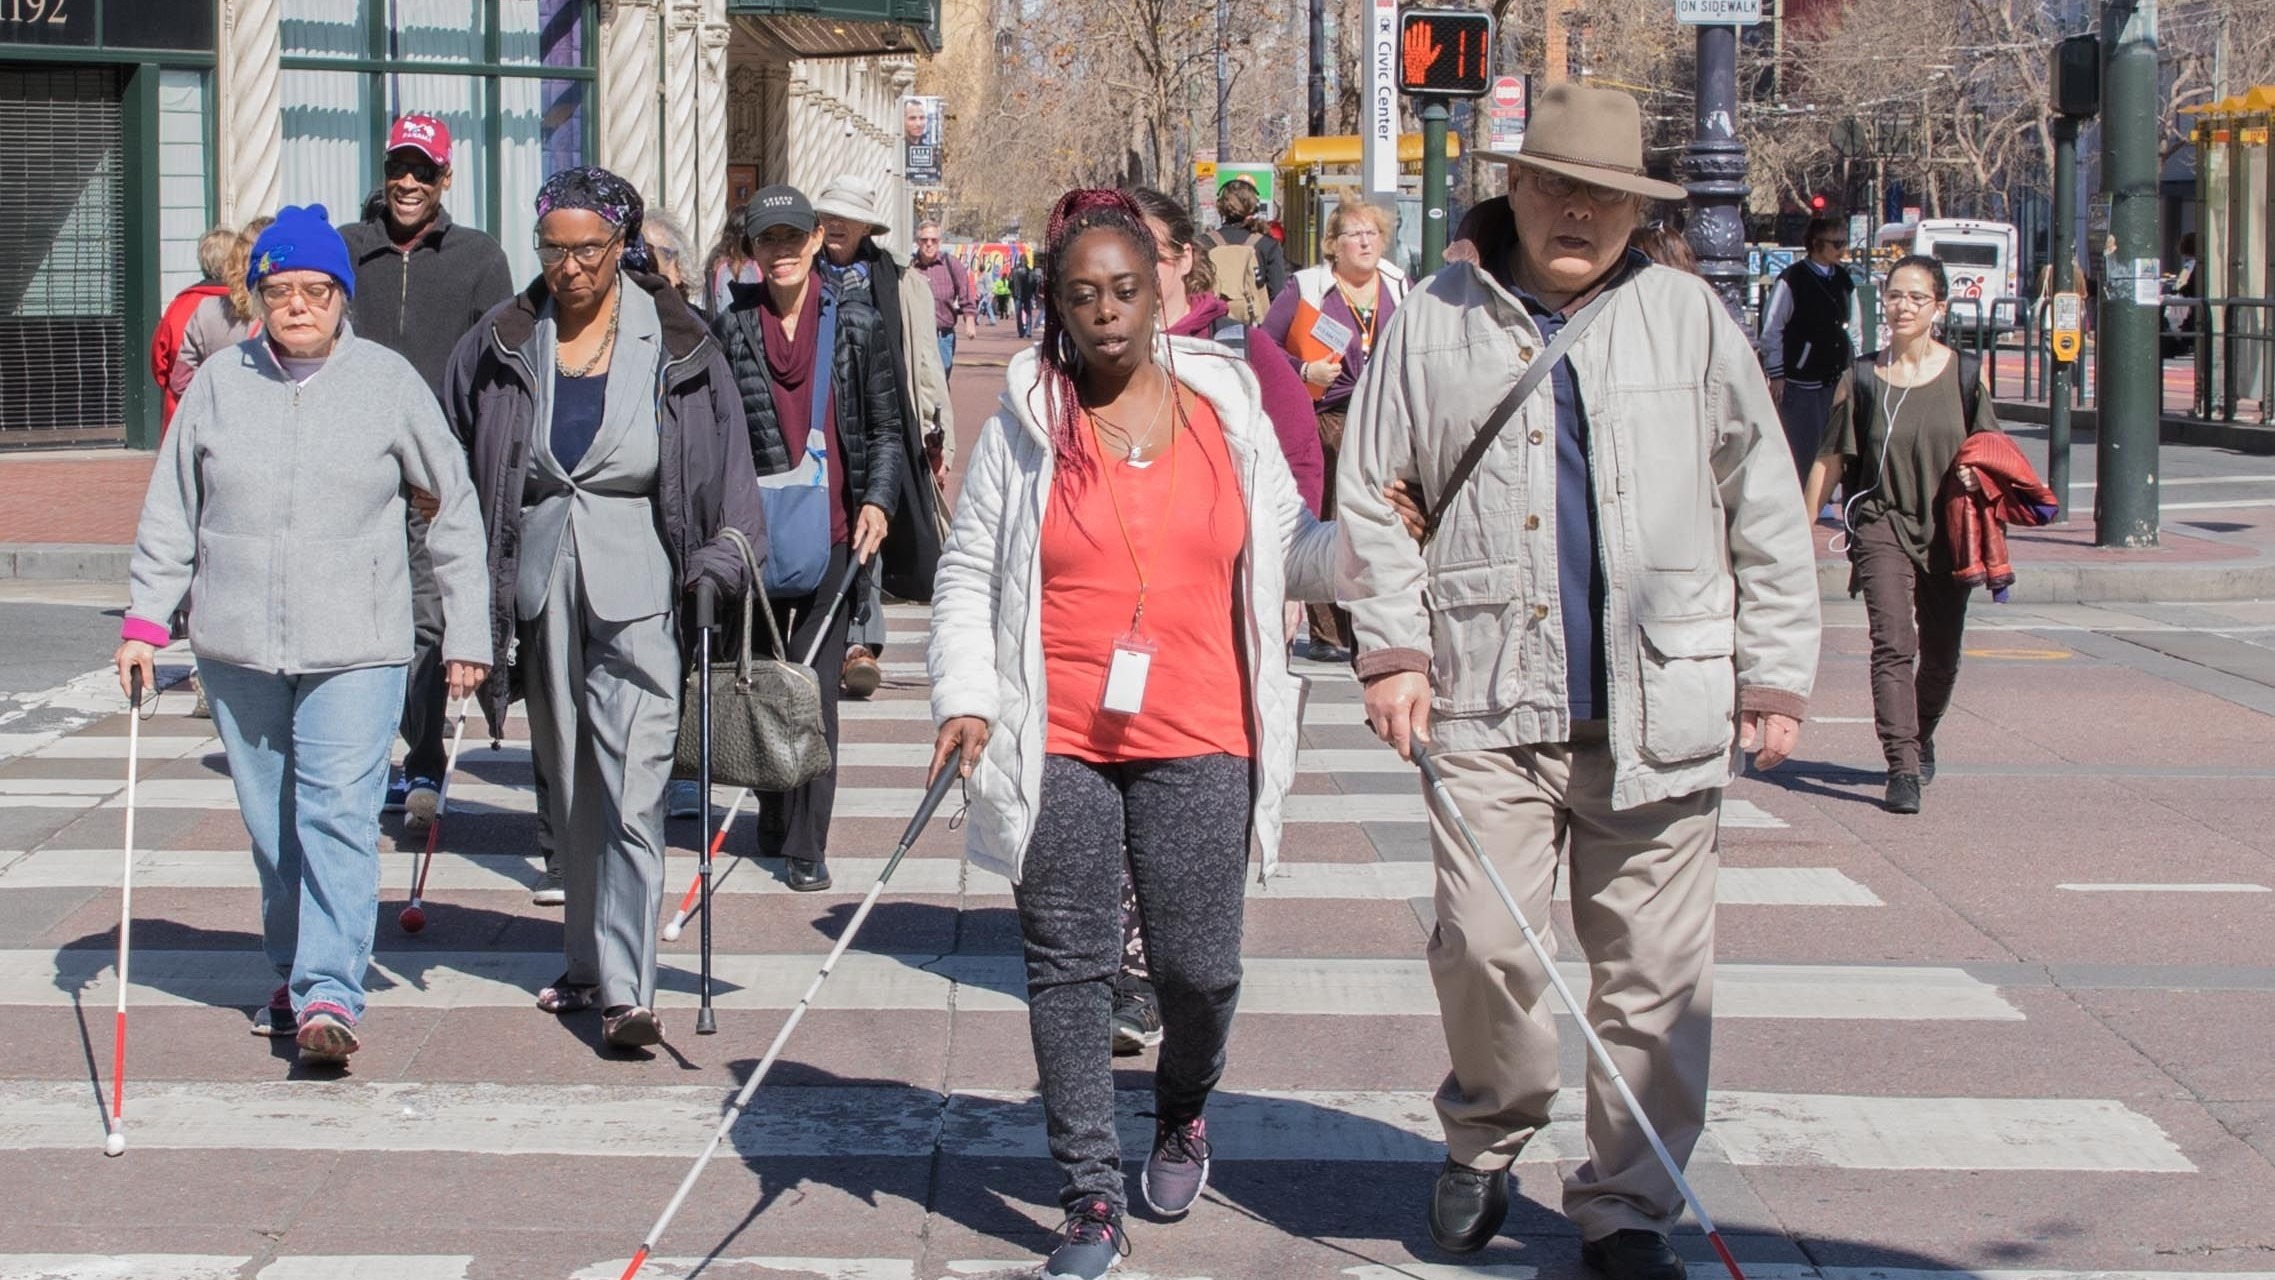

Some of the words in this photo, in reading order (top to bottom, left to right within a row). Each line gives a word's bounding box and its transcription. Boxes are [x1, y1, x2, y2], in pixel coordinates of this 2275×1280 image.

[0, 0, 68, 23] 192
[1681, 0, 1696, 12] ON
[1701, 0, 1758, 13] SIDEWALK
[1378, 41, 1392, 79] Civic
[1458, 29, 1489, 80] 11
[1378, 86, 1392, 141] Center
